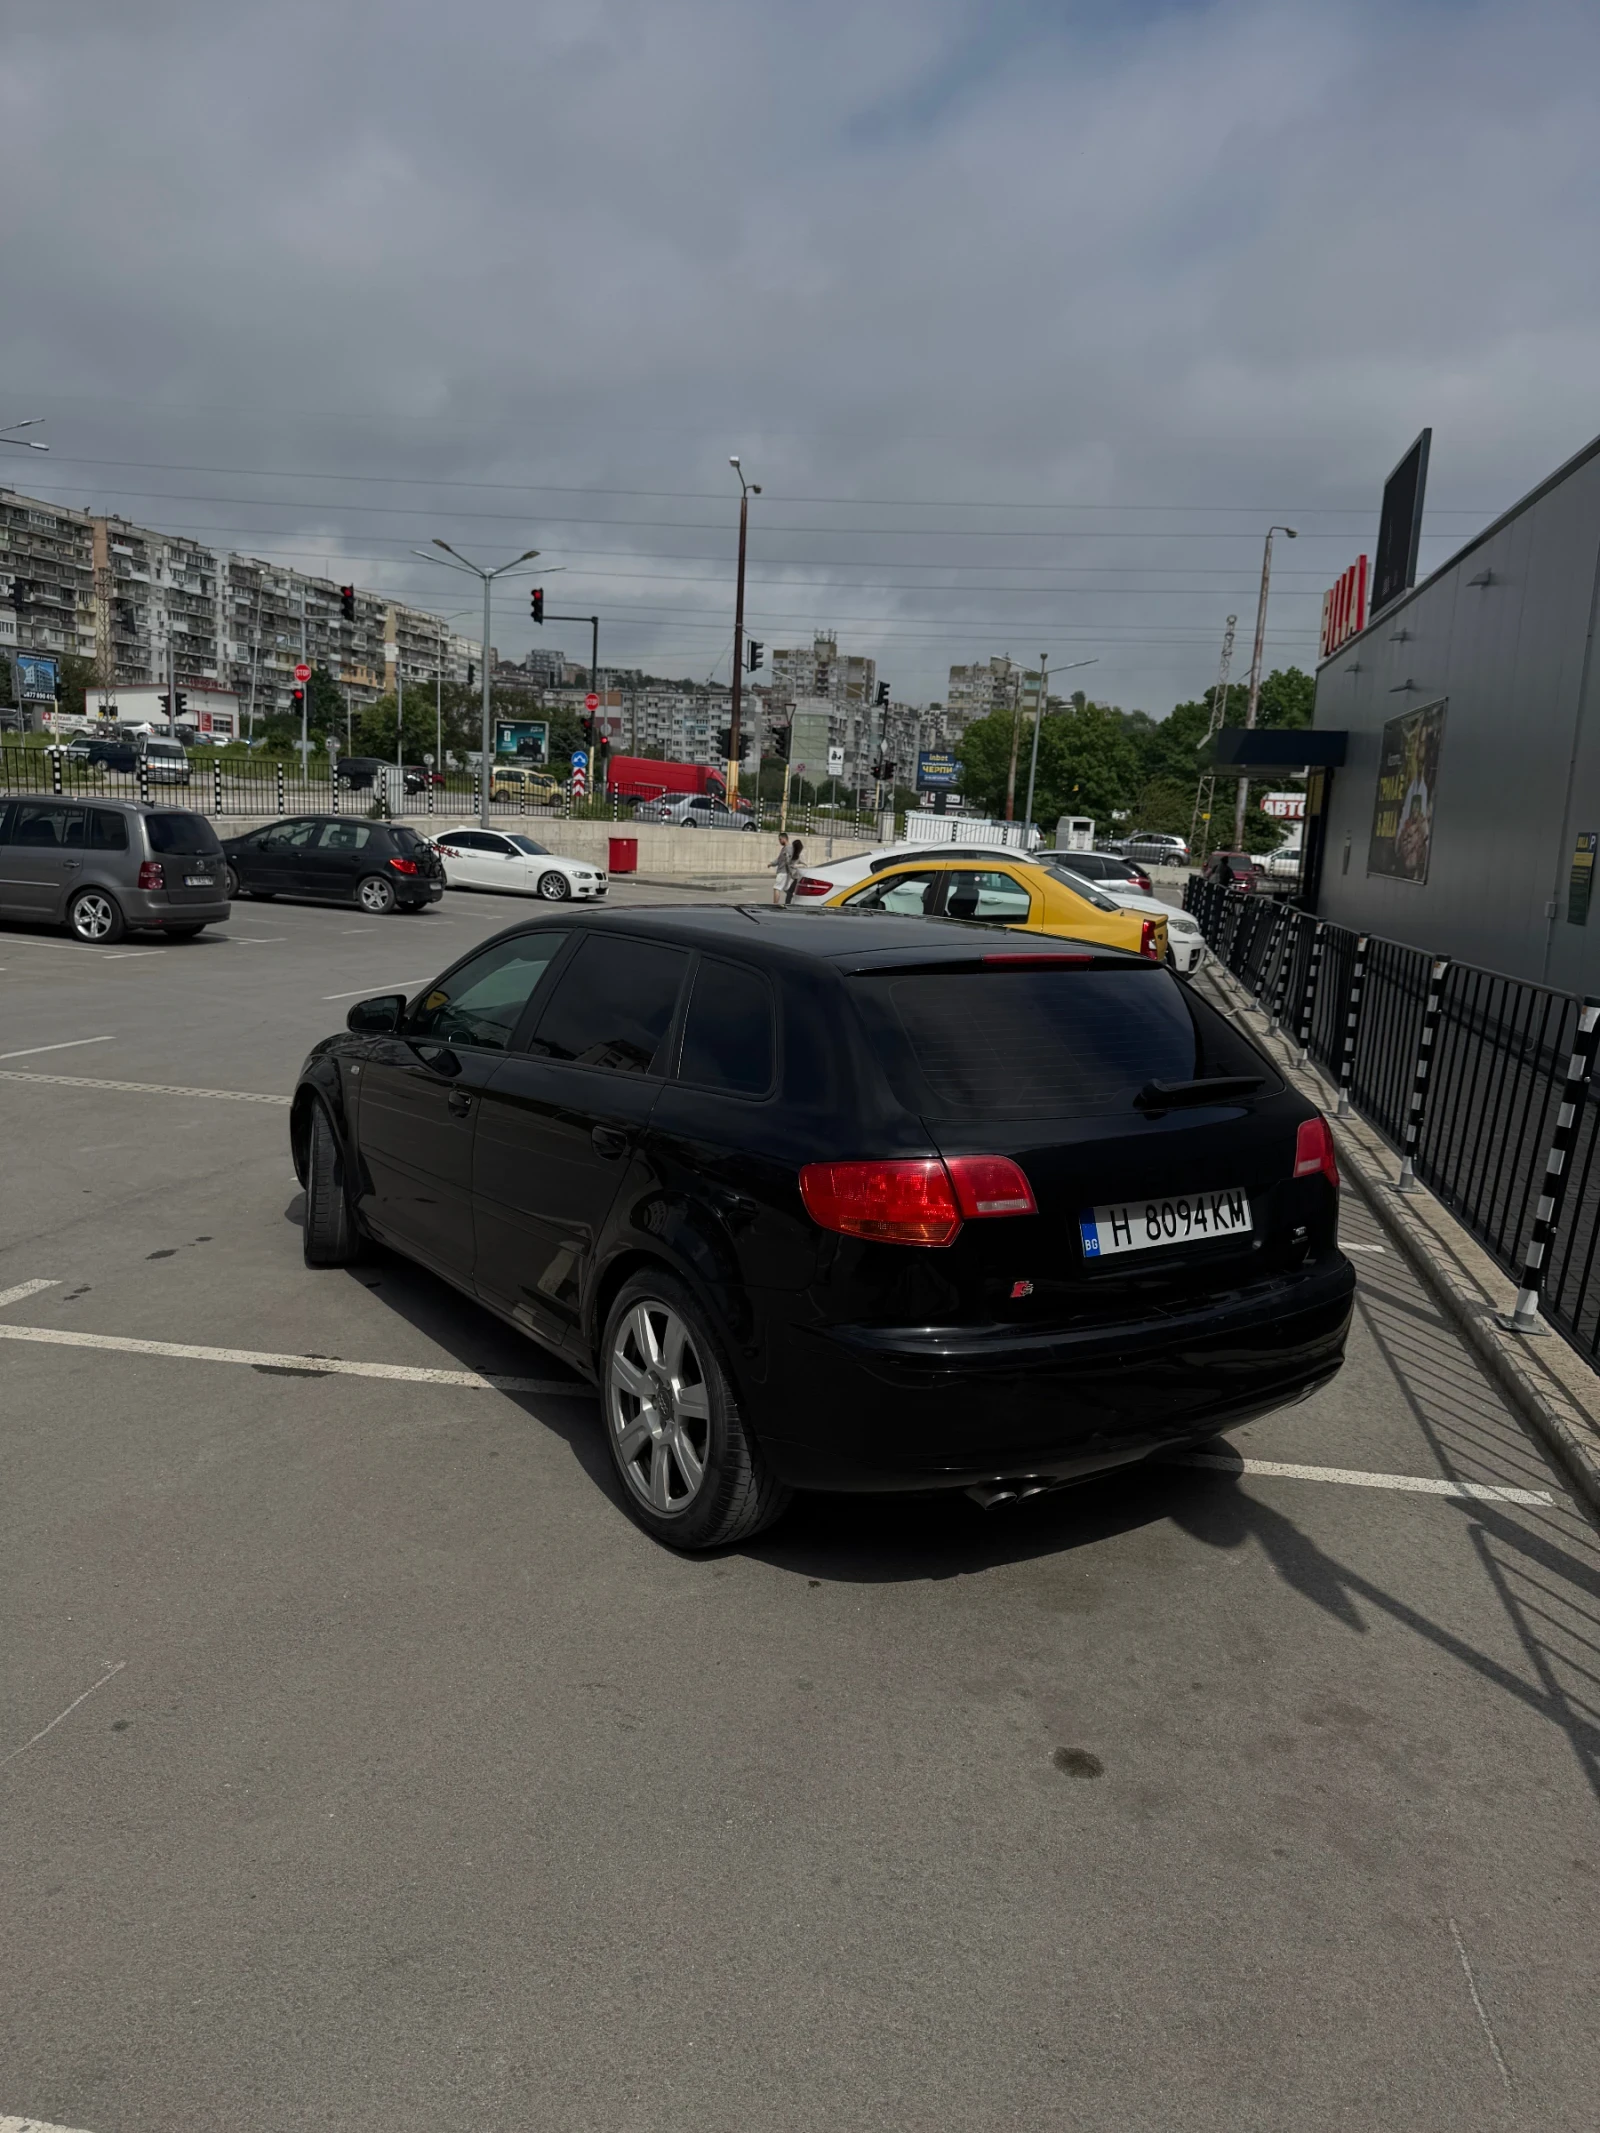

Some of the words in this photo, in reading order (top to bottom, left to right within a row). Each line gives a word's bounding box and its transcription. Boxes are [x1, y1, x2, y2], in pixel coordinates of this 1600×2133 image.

[1319, 555, 1369, 659] BILLA
[296, 669, 310, 677] STOP
[922, 766, 953, 774] ЧЕРПИ
[1589, 835, 1596, 850] P
[1110, 1208, 1132, 1247] H
[1084, 1238, 1099, 1251] BG
